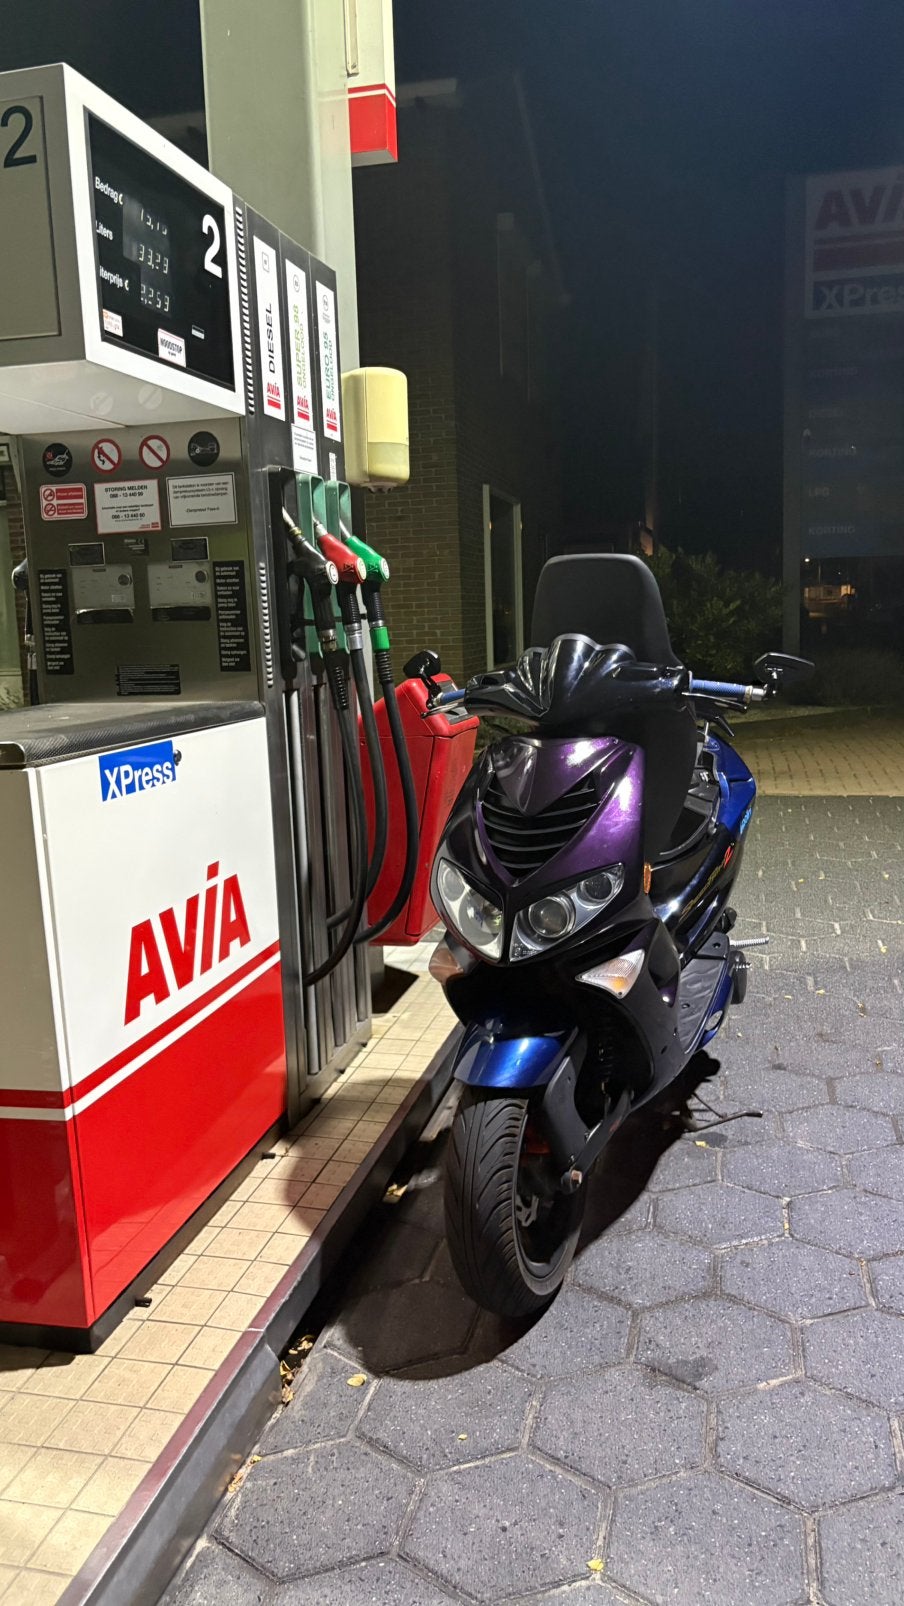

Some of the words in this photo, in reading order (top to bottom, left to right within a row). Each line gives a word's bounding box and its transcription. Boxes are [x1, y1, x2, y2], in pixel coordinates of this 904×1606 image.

[1, 105, 37, 169] 2
[95, 175, 118, 204] Bedrag
[202, 214, 223, 279] 2
[265, 302, 276, 375] DIESEL
[294, 328, 304, 388] SUPER
[266, 381, 281, 398] AVIA
[322, 356, 332, 400] EURO
[296, 394, 310, 410] AVIA
[326, 407, 338, 421] AVIA
[103, 761, 174, 801] XPress
[124, 860, 251, 1026] AVIA
